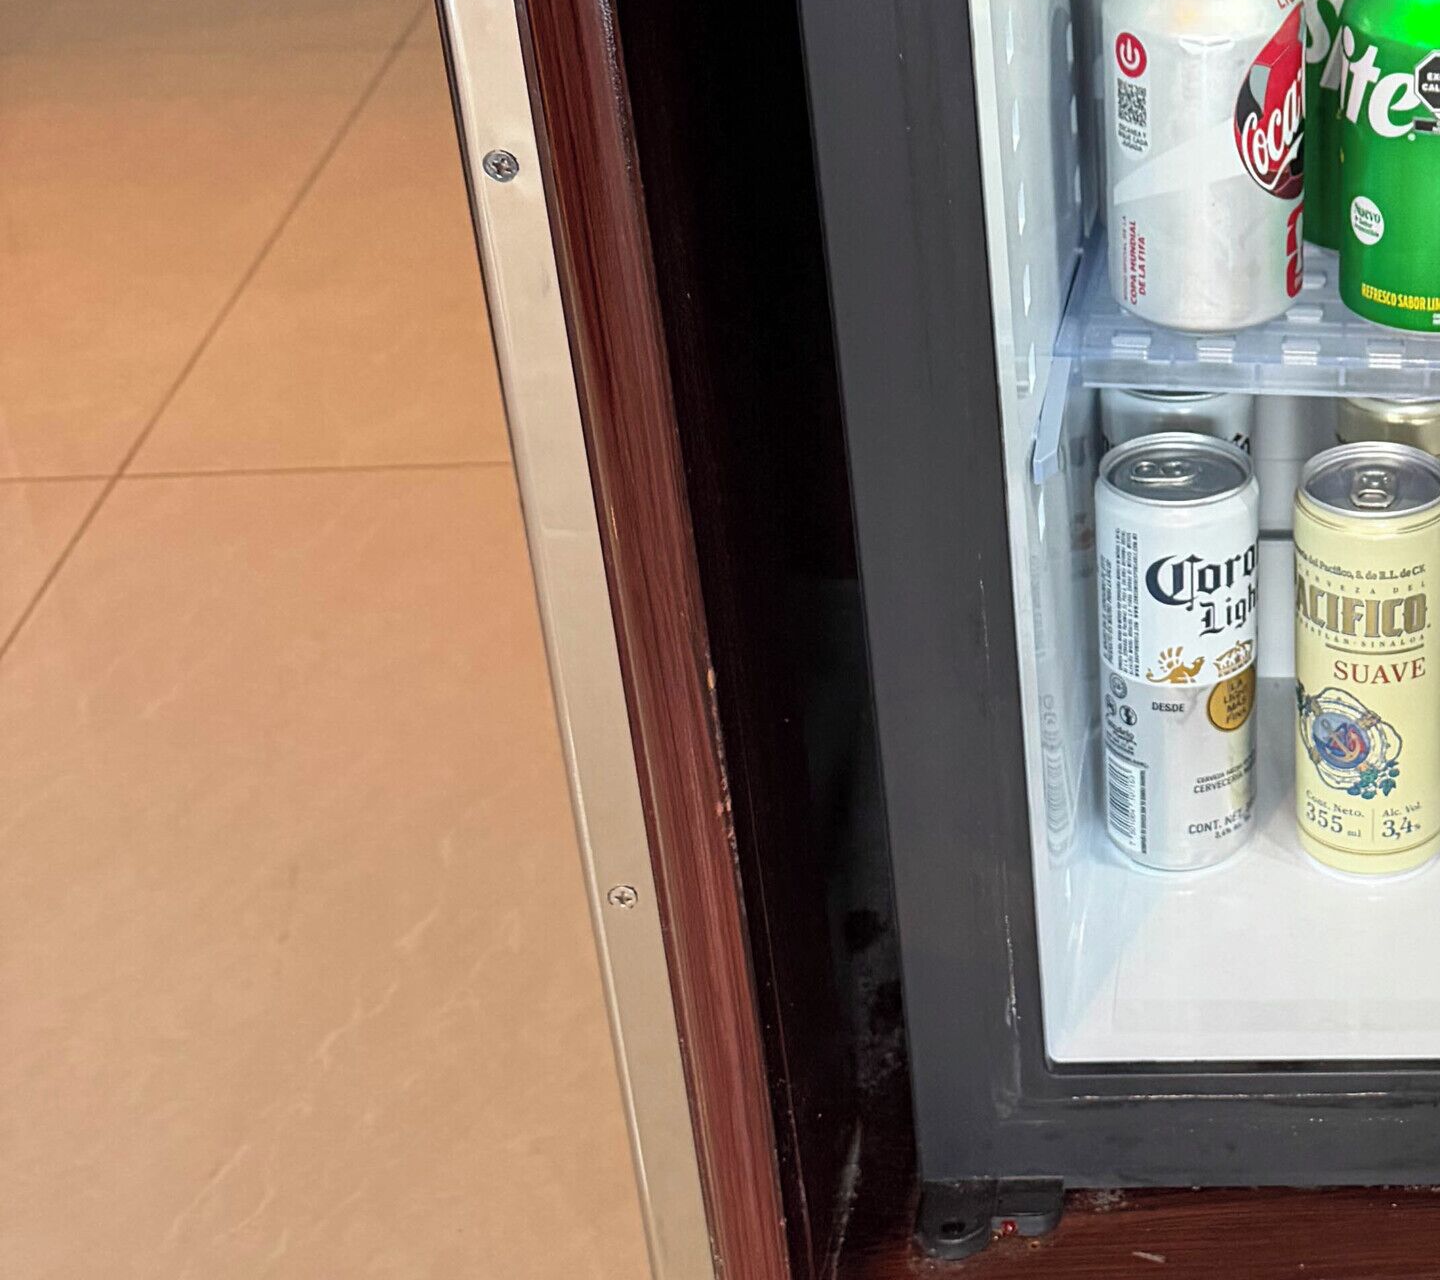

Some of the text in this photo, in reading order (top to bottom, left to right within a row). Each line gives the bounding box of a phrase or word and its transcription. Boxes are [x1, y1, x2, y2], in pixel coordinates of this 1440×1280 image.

[1340, 25, 1421, 137] ite
[1361, 282, 1397, 307] REFRESCO
[1398, 294, 1426, 311] SABOR
[1145, 544, 1256, 611] Coro
[1199, 583, 1256, 638] Ligh
[1297, 574, 1428, 639] ACIFICO
[1333, 656, 1426, 685] SUAVE
[1151, 701, 1186, 713] DESDE
[1187, 818, 1223, 836] CONT.
[1306, 801, 1343, 834] 355
